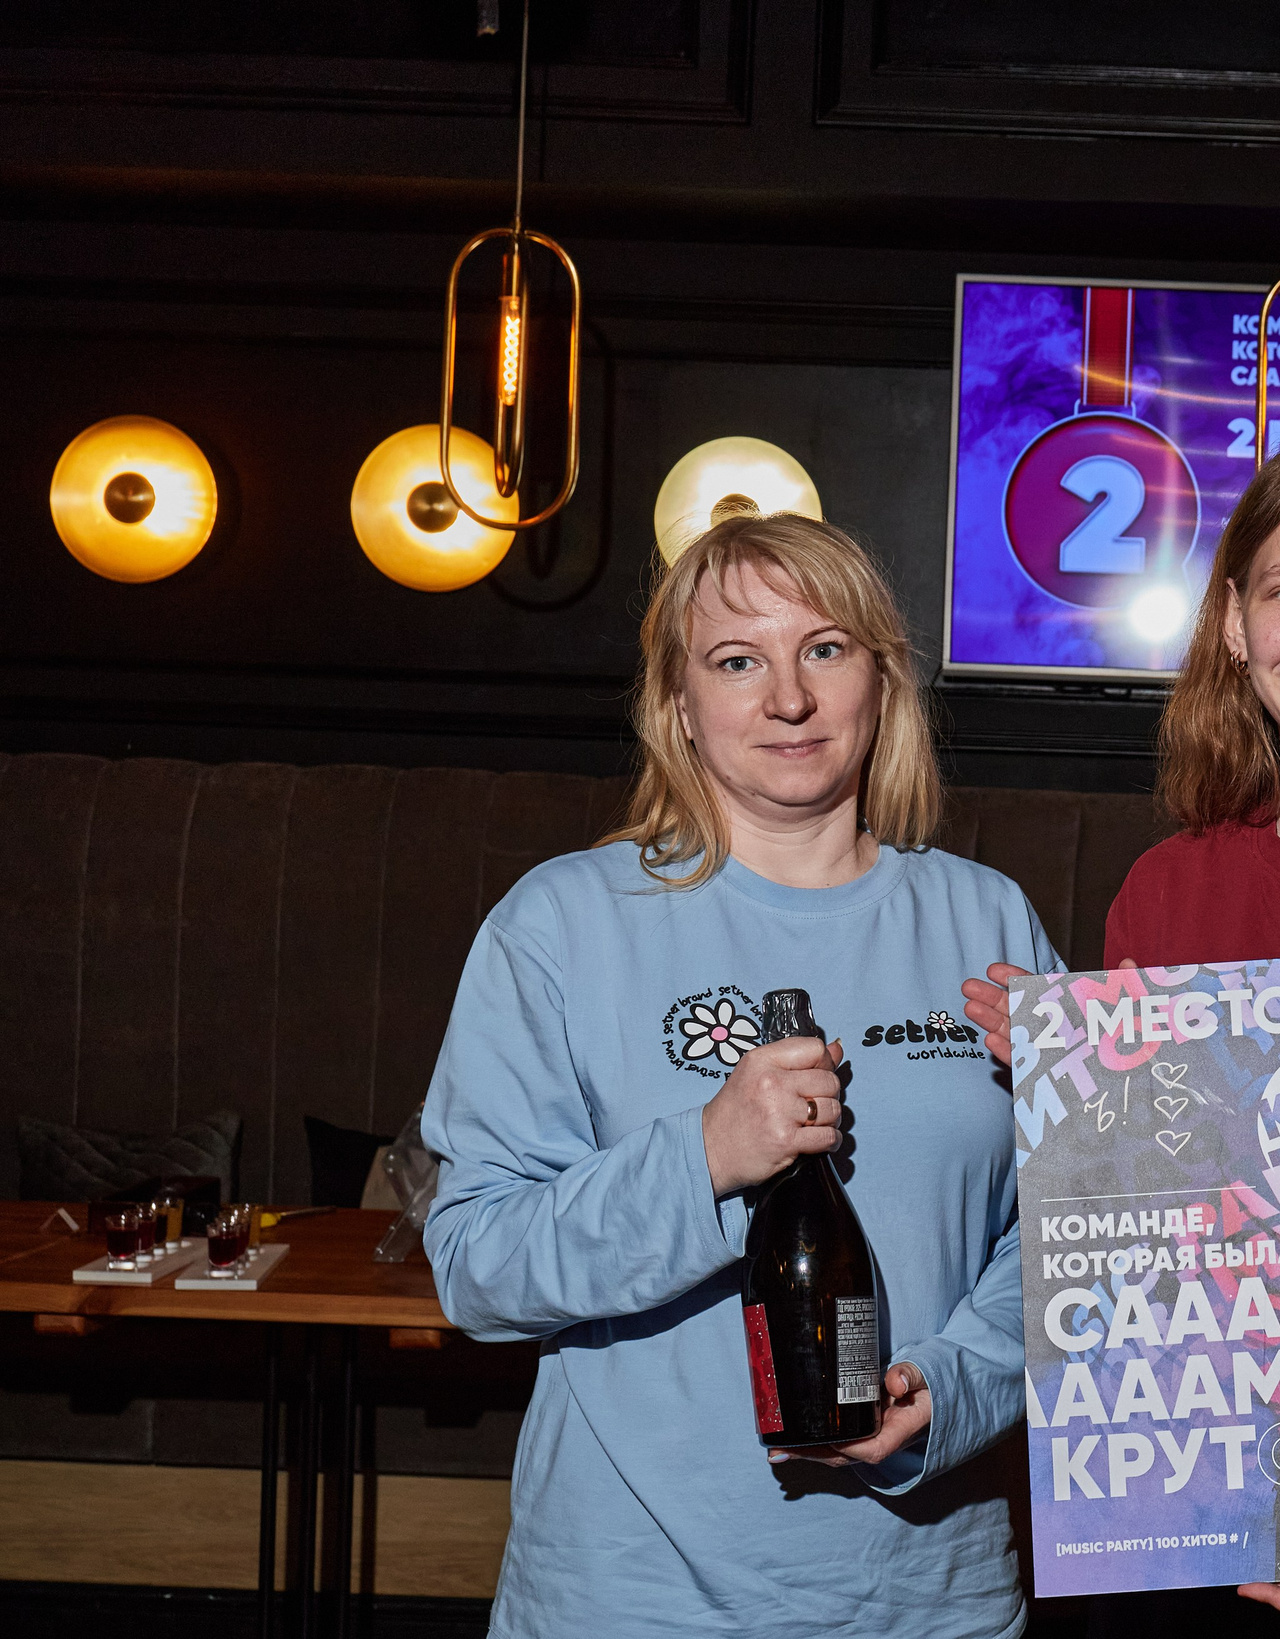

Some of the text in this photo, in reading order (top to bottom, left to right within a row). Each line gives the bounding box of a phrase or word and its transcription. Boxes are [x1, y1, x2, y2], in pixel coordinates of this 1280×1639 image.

[1227, 417, 1256, 458] 2
[1058, 455, 1146, 573] 2
[677, 987, 713, 1008] brand
[1031, 1000, 1067, 1050] 2
[906, 1045, 986, 1060] worldwide
[1041, 1207, 1215, 1243] КОМАНДЕ,
[1042, 1244, 1197, 1280] КОТОРАЯ
[1056, 1541, 1104, 1557] [MUSIC
[1106, 1537, 1153, 1552] PARTY]
[1155, 1536, 1179, 1549] 100
[1181, 1533, 1227, 1548] ХИТОВ
